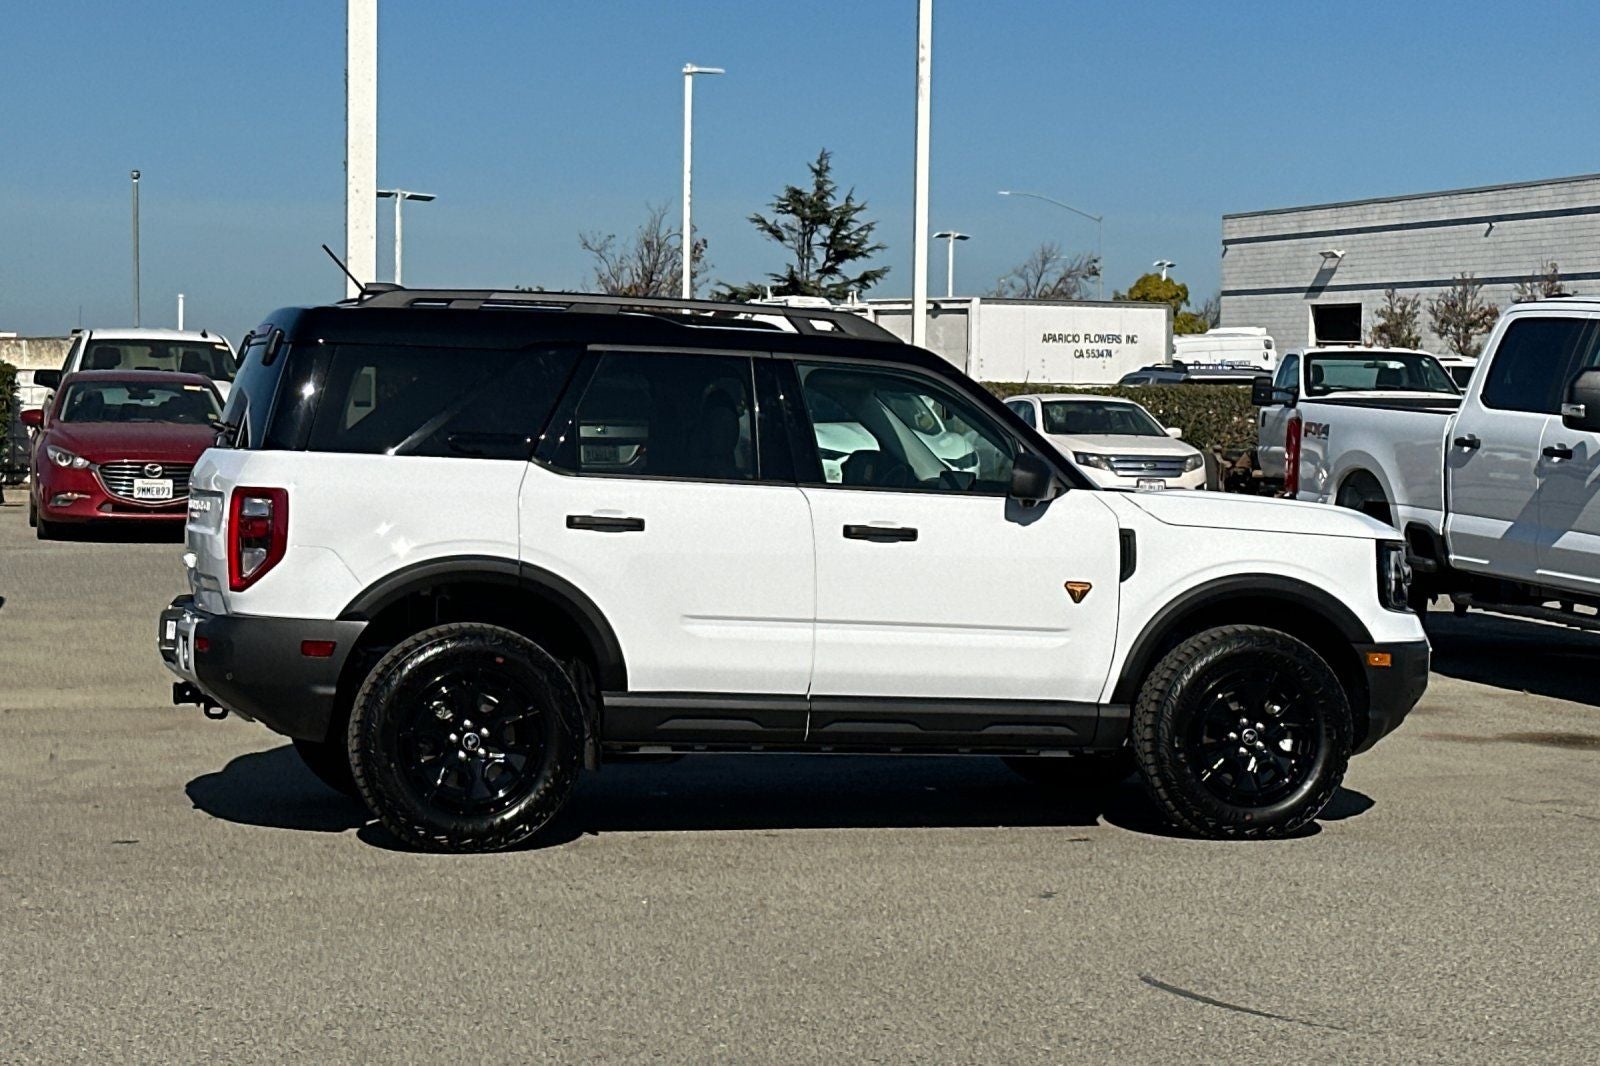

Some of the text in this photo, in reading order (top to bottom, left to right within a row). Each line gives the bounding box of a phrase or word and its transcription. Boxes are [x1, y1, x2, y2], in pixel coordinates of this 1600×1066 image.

[1041, 333, 1138, 344] APARICIO FLOWERS INC
[1073, 348, 1085, 359] CA
